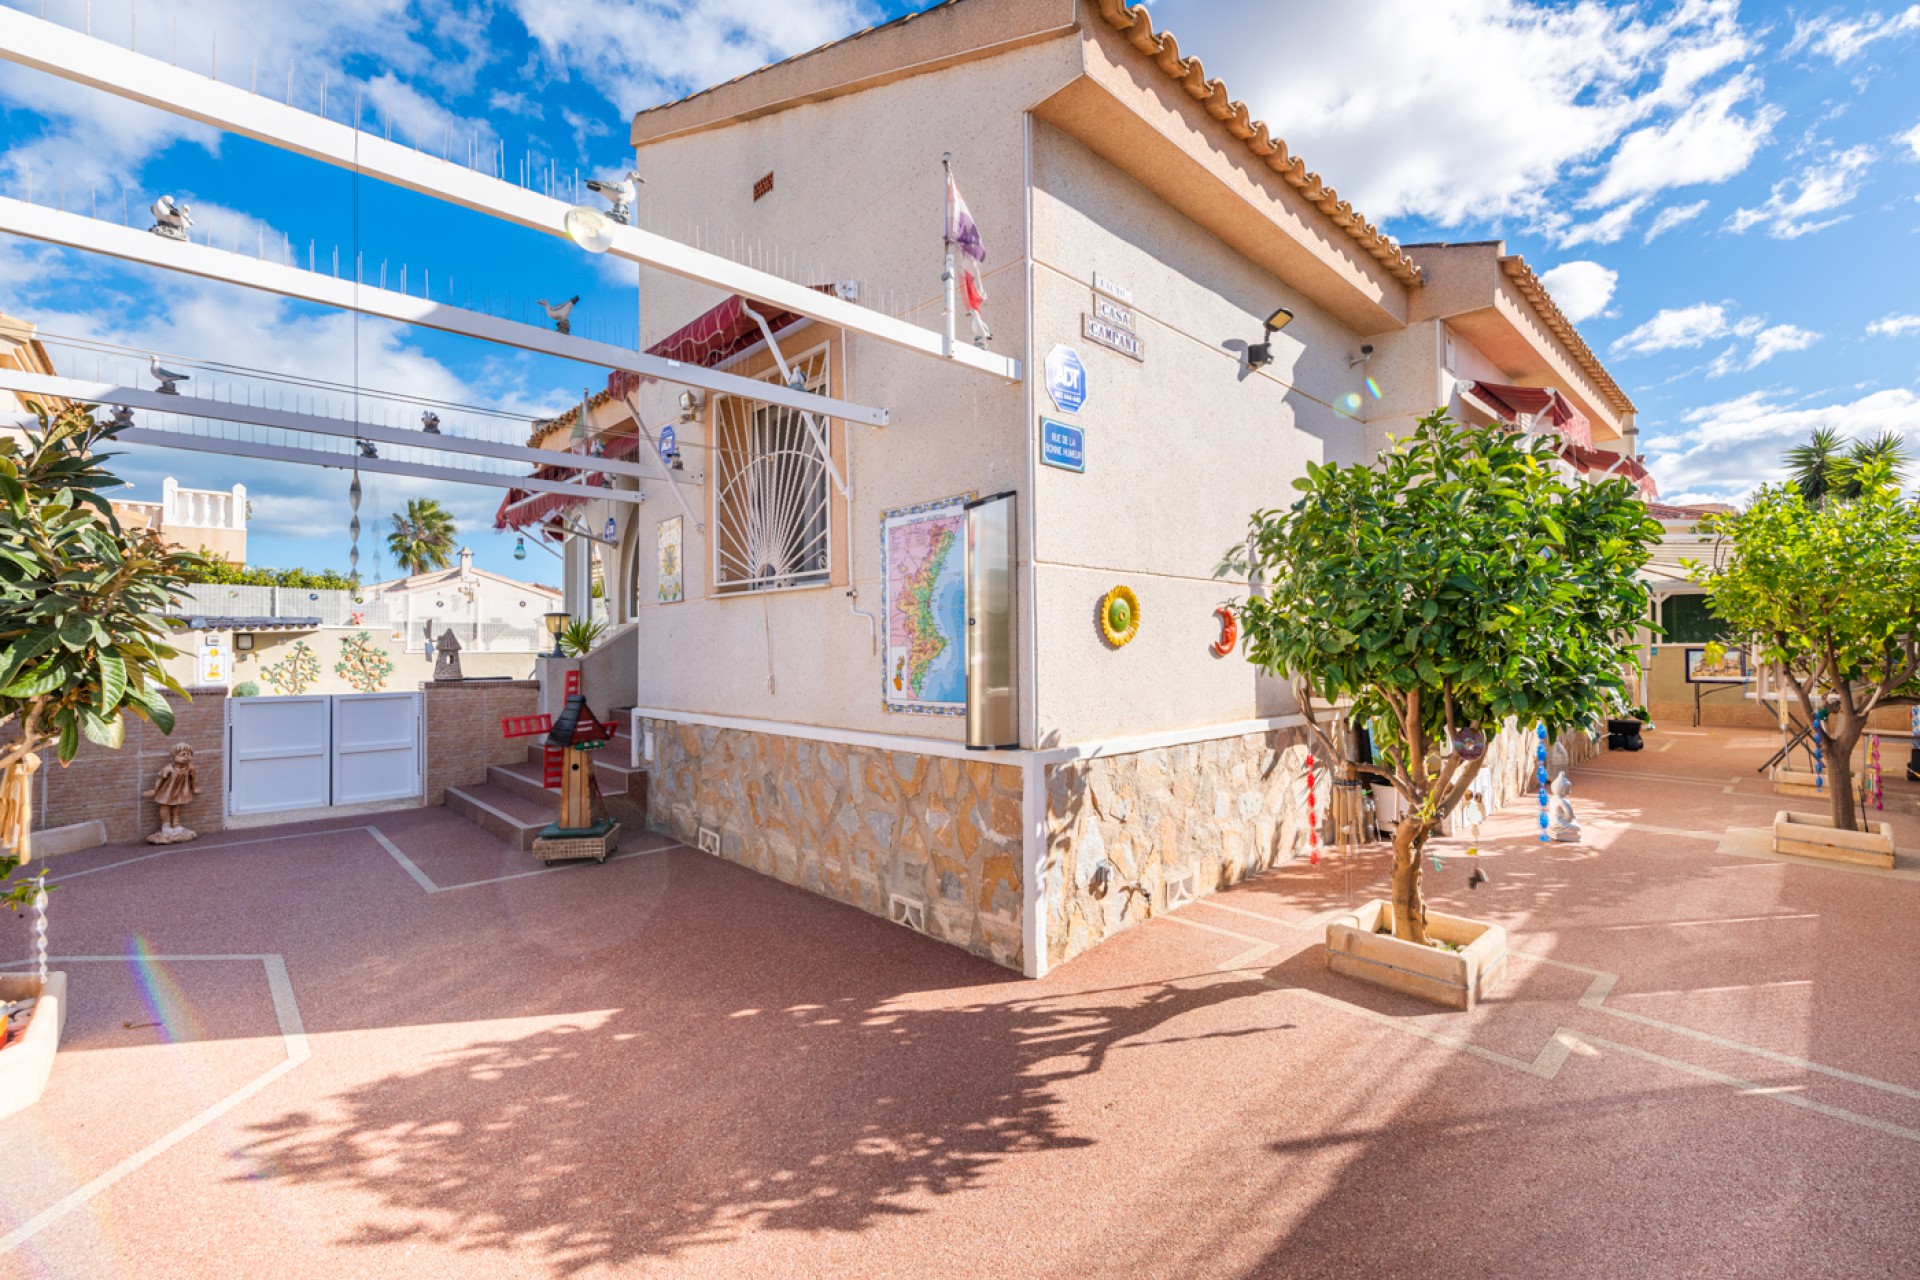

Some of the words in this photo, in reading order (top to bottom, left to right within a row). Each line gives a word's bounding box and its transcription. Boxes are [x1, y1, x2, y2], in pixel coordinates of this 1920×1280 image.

[1101, 304, 1129, 326] CASA
[1091, 322, 1137, 353] CAMPANI
[1055, 365, 1080, 389] ADT
[1051, 432, 1062, 444] RUE
[1062, 434, 1069, 445] DE
[1069, 436, 1076, 447] LA
